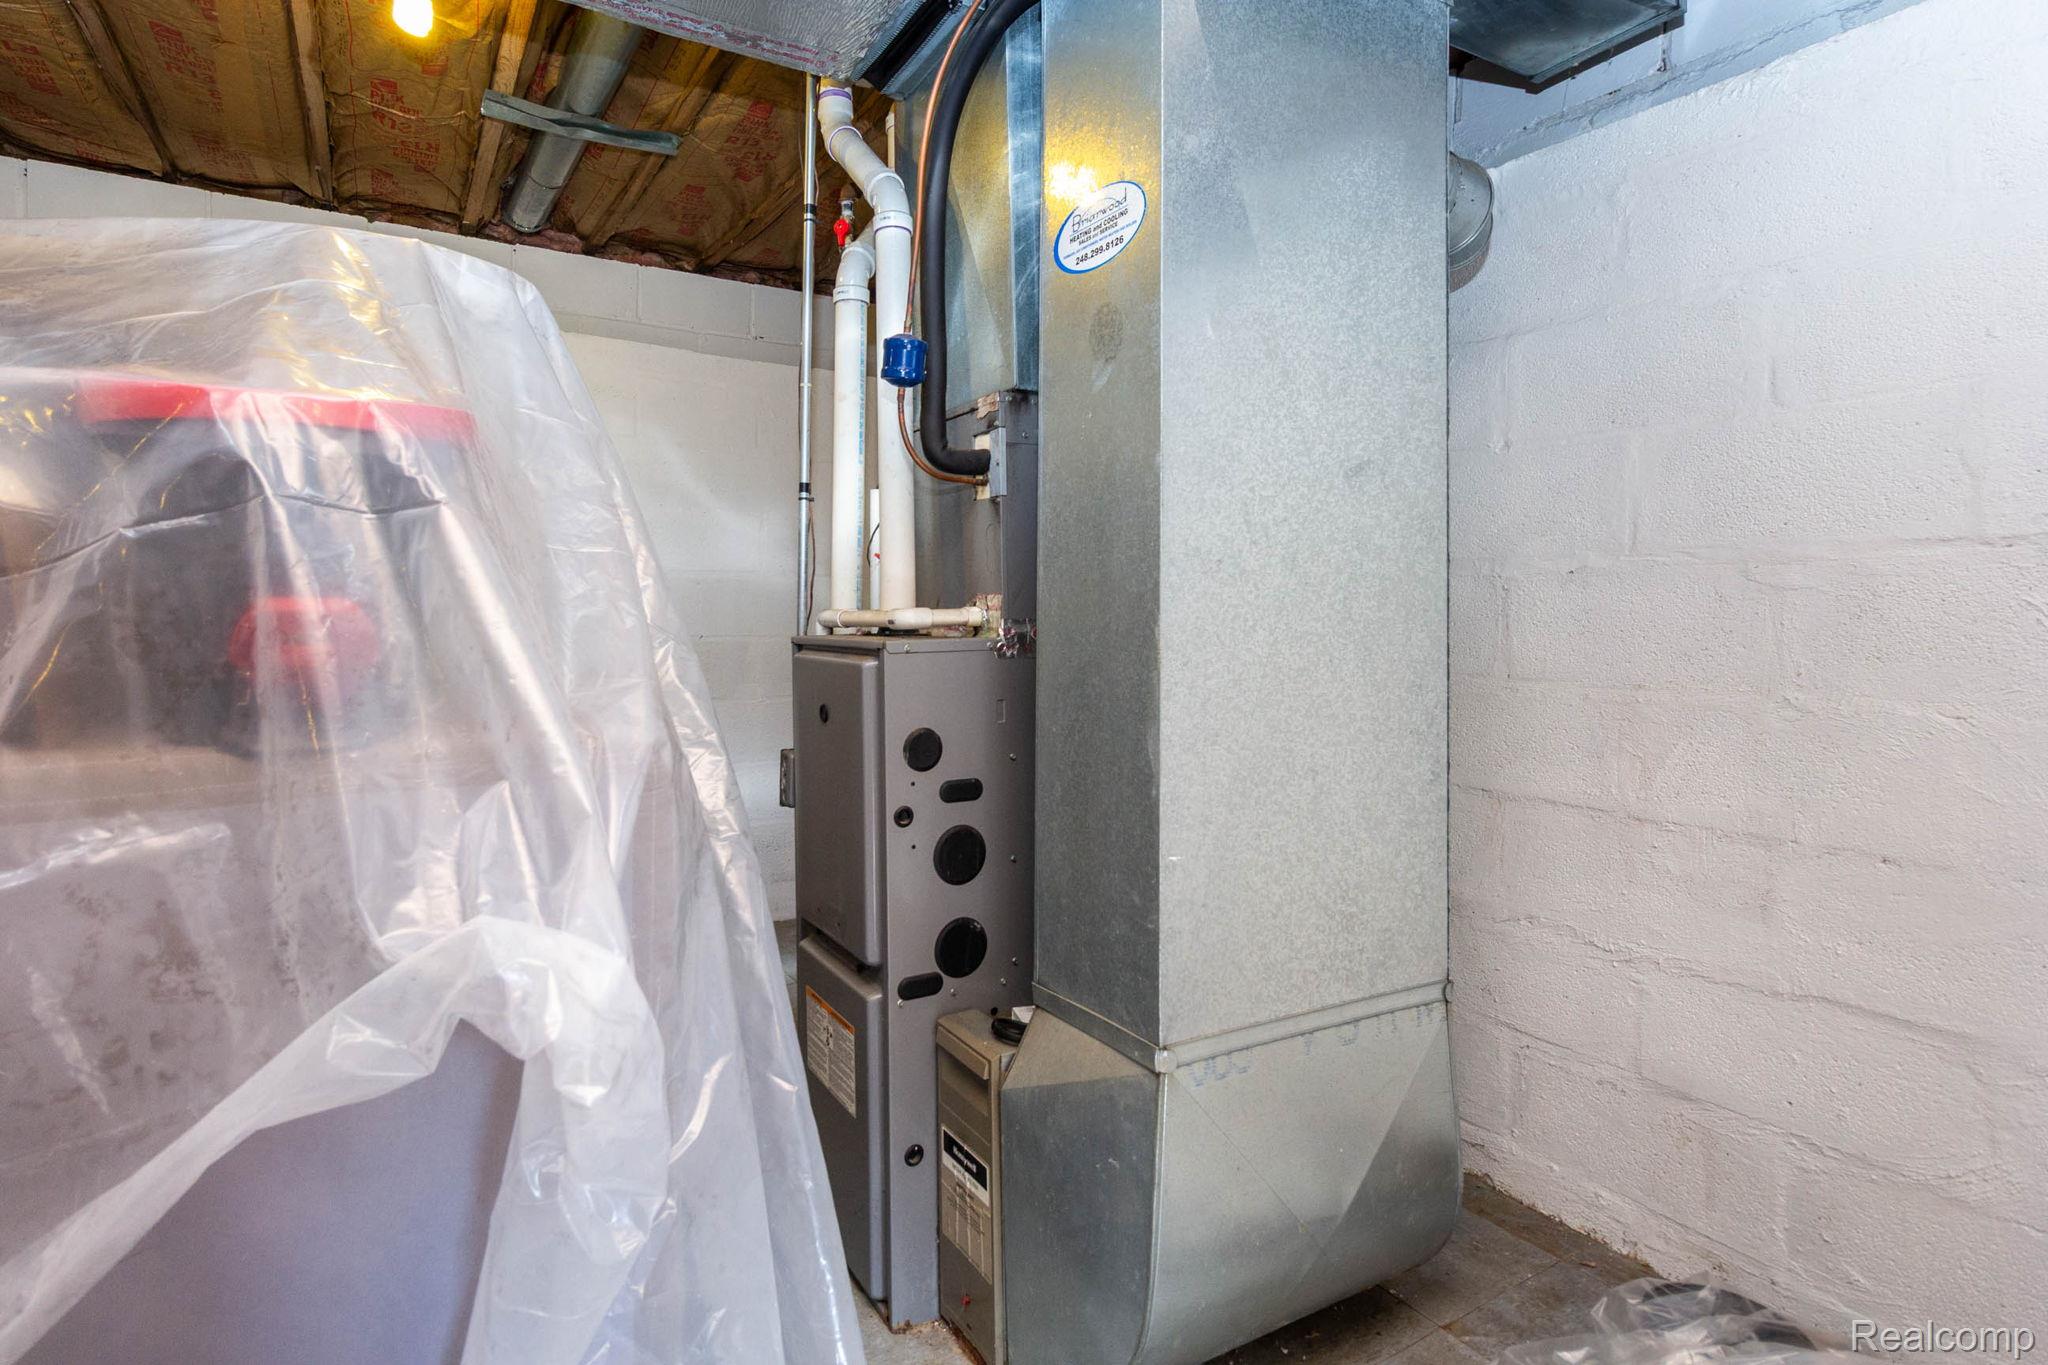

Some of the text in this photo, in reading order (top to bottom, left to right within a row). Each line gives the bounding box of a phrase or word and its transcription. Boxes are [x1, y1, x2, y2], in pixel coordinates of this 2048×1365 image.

[1072, 186, 1128, 233] Briarwood
[1069, 227, 1093, 245] HEATING
[1093, 222, 1103, 233] and
[1103, 208, 1129, 227] COOLING
[1078, 234, 1092, 246] SALES
[1099, 221, 1119, 236] SERVICE
[1075, 235, 1124, 265] 248.299.8126
